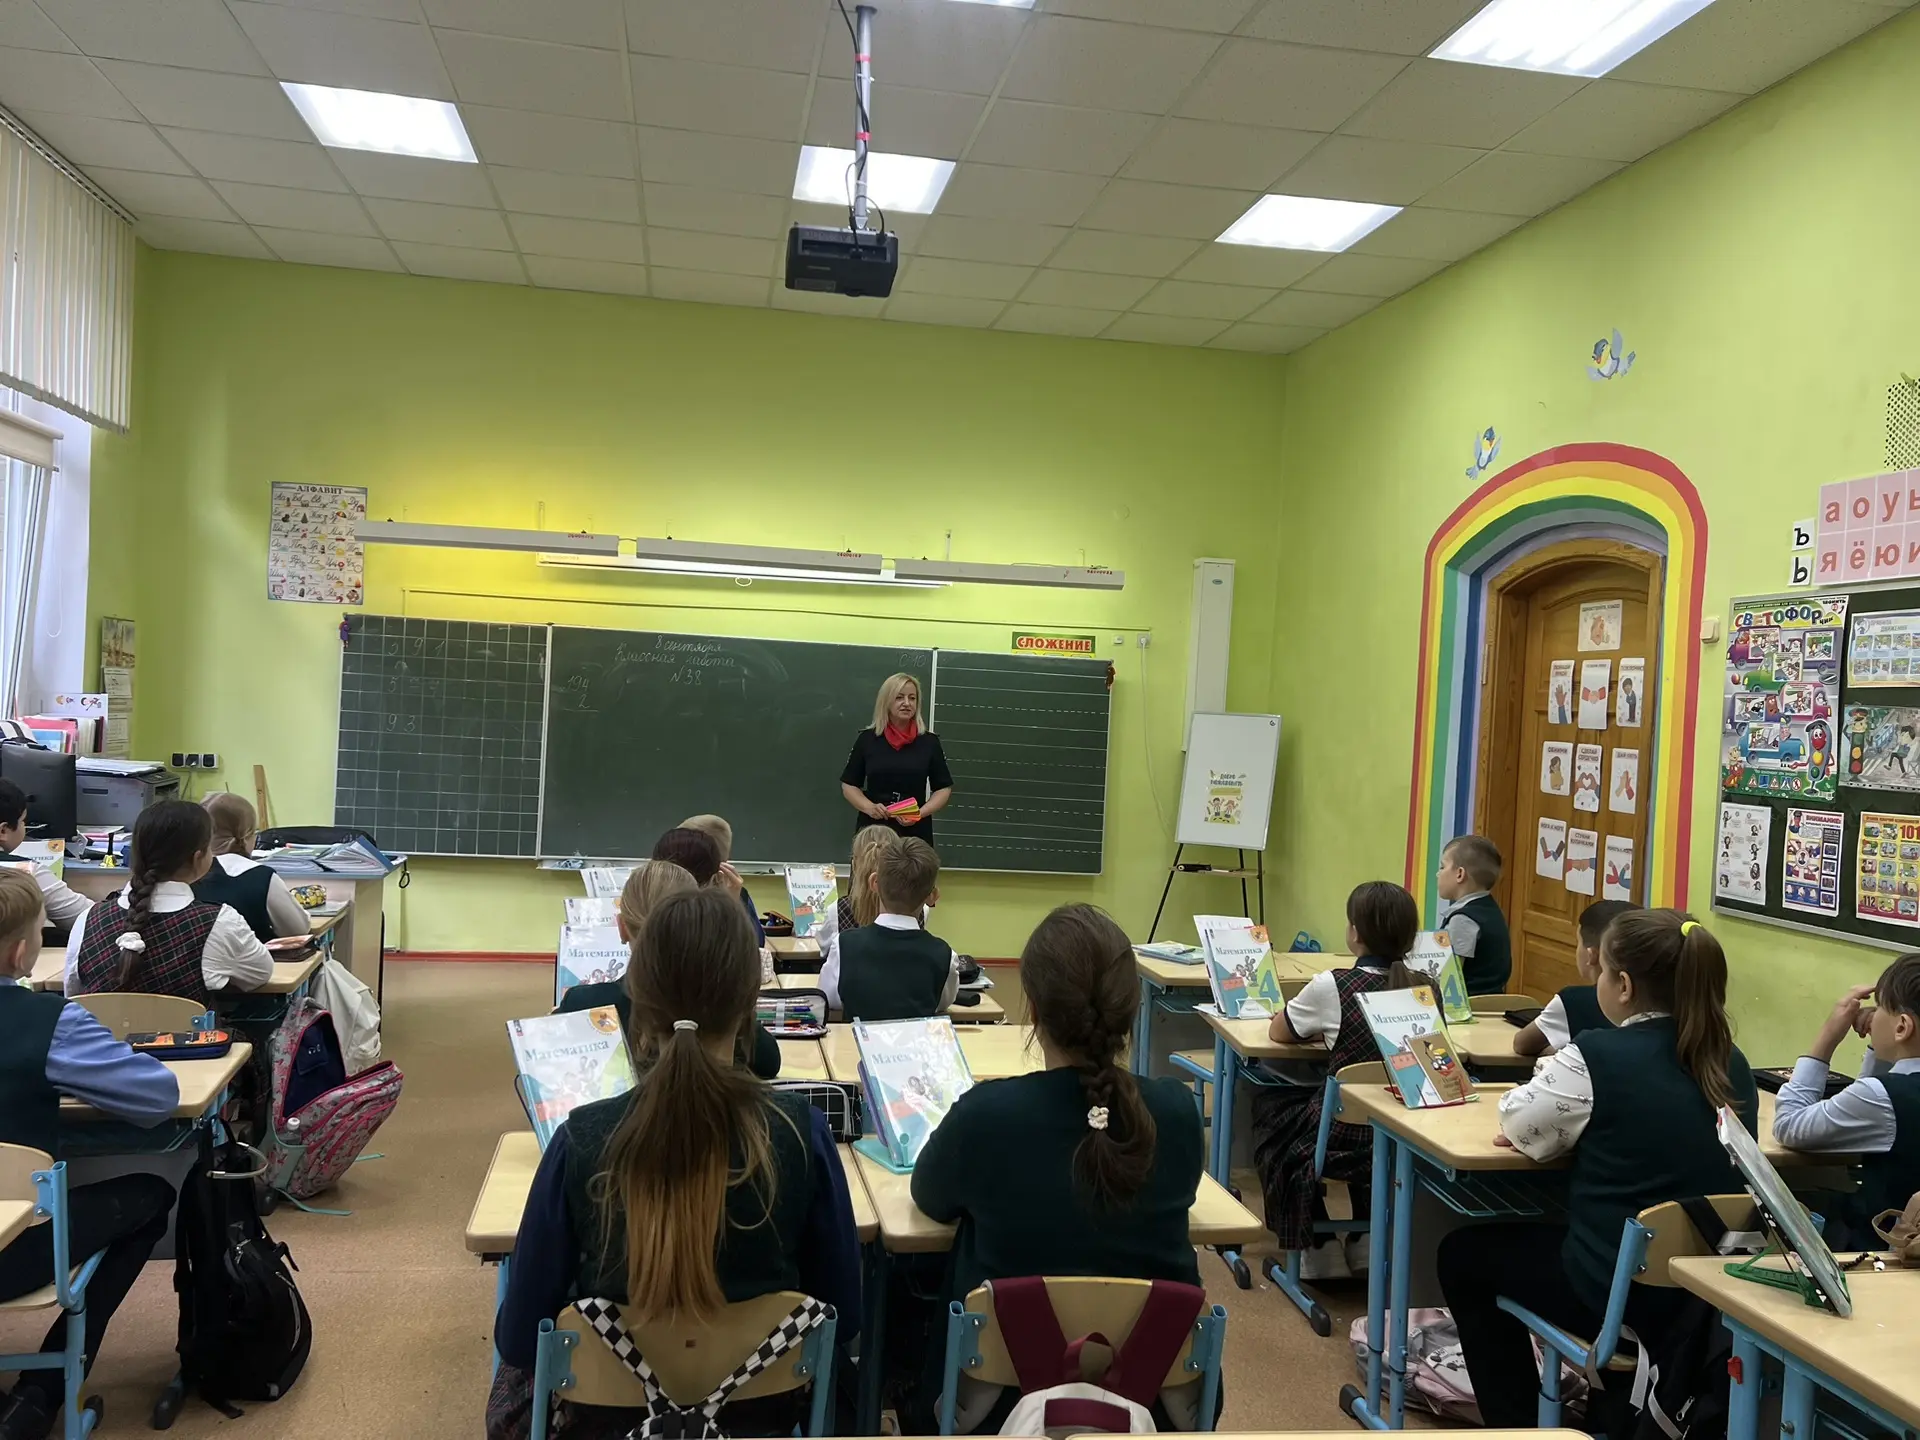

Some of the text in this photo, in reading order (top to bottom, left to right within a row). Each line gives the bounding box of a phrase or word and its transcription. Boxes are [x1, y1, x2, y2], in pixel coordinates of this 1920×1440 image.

[296, 485, 343, 494] АЛФАВИТ
[1825, 501, 1840, 523] а
[1853, 497, 1870, 518] о
[1882, 491, 1900, 522] у
[1820, 551, 1837, 572] я
[1850, 540, 1866, 570] ё
[1875, 544, 1900, 567] ю
[1734, 607, 1823, 629] СВЕТОФОР
[615, 643, 676, 663] Классная
[1017, 637, 1091, 651] СЛОЖЕНИЕ
[578, 694, 590, 709] 2
[1216, 946, 1263, 955] Математика
[1259, 969, 1280, 1004] 4
[1443, 974, 1463, 1009] 4
[1373, 1012, 1432, 1024] Математика
[524, 1039, 610, 1062] Математика
